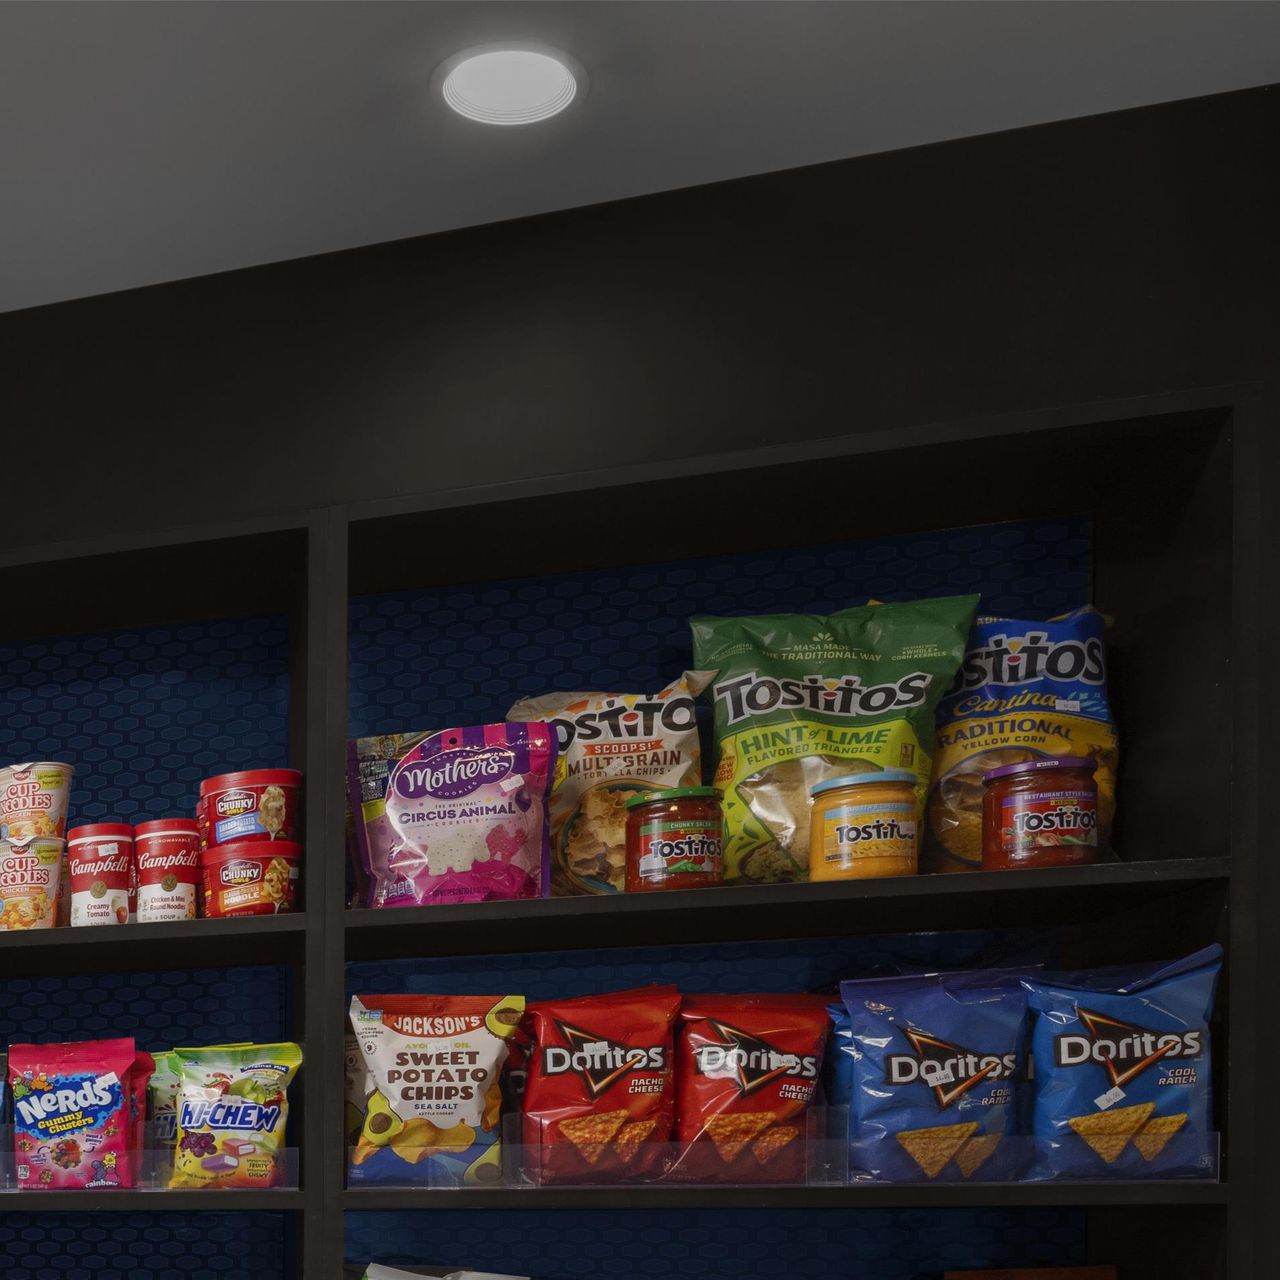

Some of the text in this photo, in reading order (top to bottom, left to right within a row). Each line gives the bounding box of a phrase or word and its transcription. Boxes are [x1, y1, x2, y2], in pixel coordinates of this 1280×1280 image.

[714, 672, 932, 725] TOSTITOS
[740, 725, 890, 756] HINT LIME
[961, 735, 1046, 750] YELLOW CORN
[747, 743, 881, 765] FLAVORED TRIANGLES
[218, 798, 256, 811] CHUNKY
[398, 802, 516, 824] CIRCUS ANIMAL
[222, 867, 261, 880] CHUNKY
[394, 1016, 480, 1036] JACKSON'S
[1059, 1032, 1201, 1065] Doritos
[395, 1051, 480, 1067] SWEET
[387, 1068, 488, 1084] POTATO
[1158, 1076, 1197, 1086] RANCH
[1167, 1068, 1196, 1078] COOL
[628, 1085, 664, 1095] CHEESE
[631, 1079, 664, 1087] NACHO
[400, 1085, 474, 1101] CHIPS
[38, 1111, 83, 1130] Gummy
